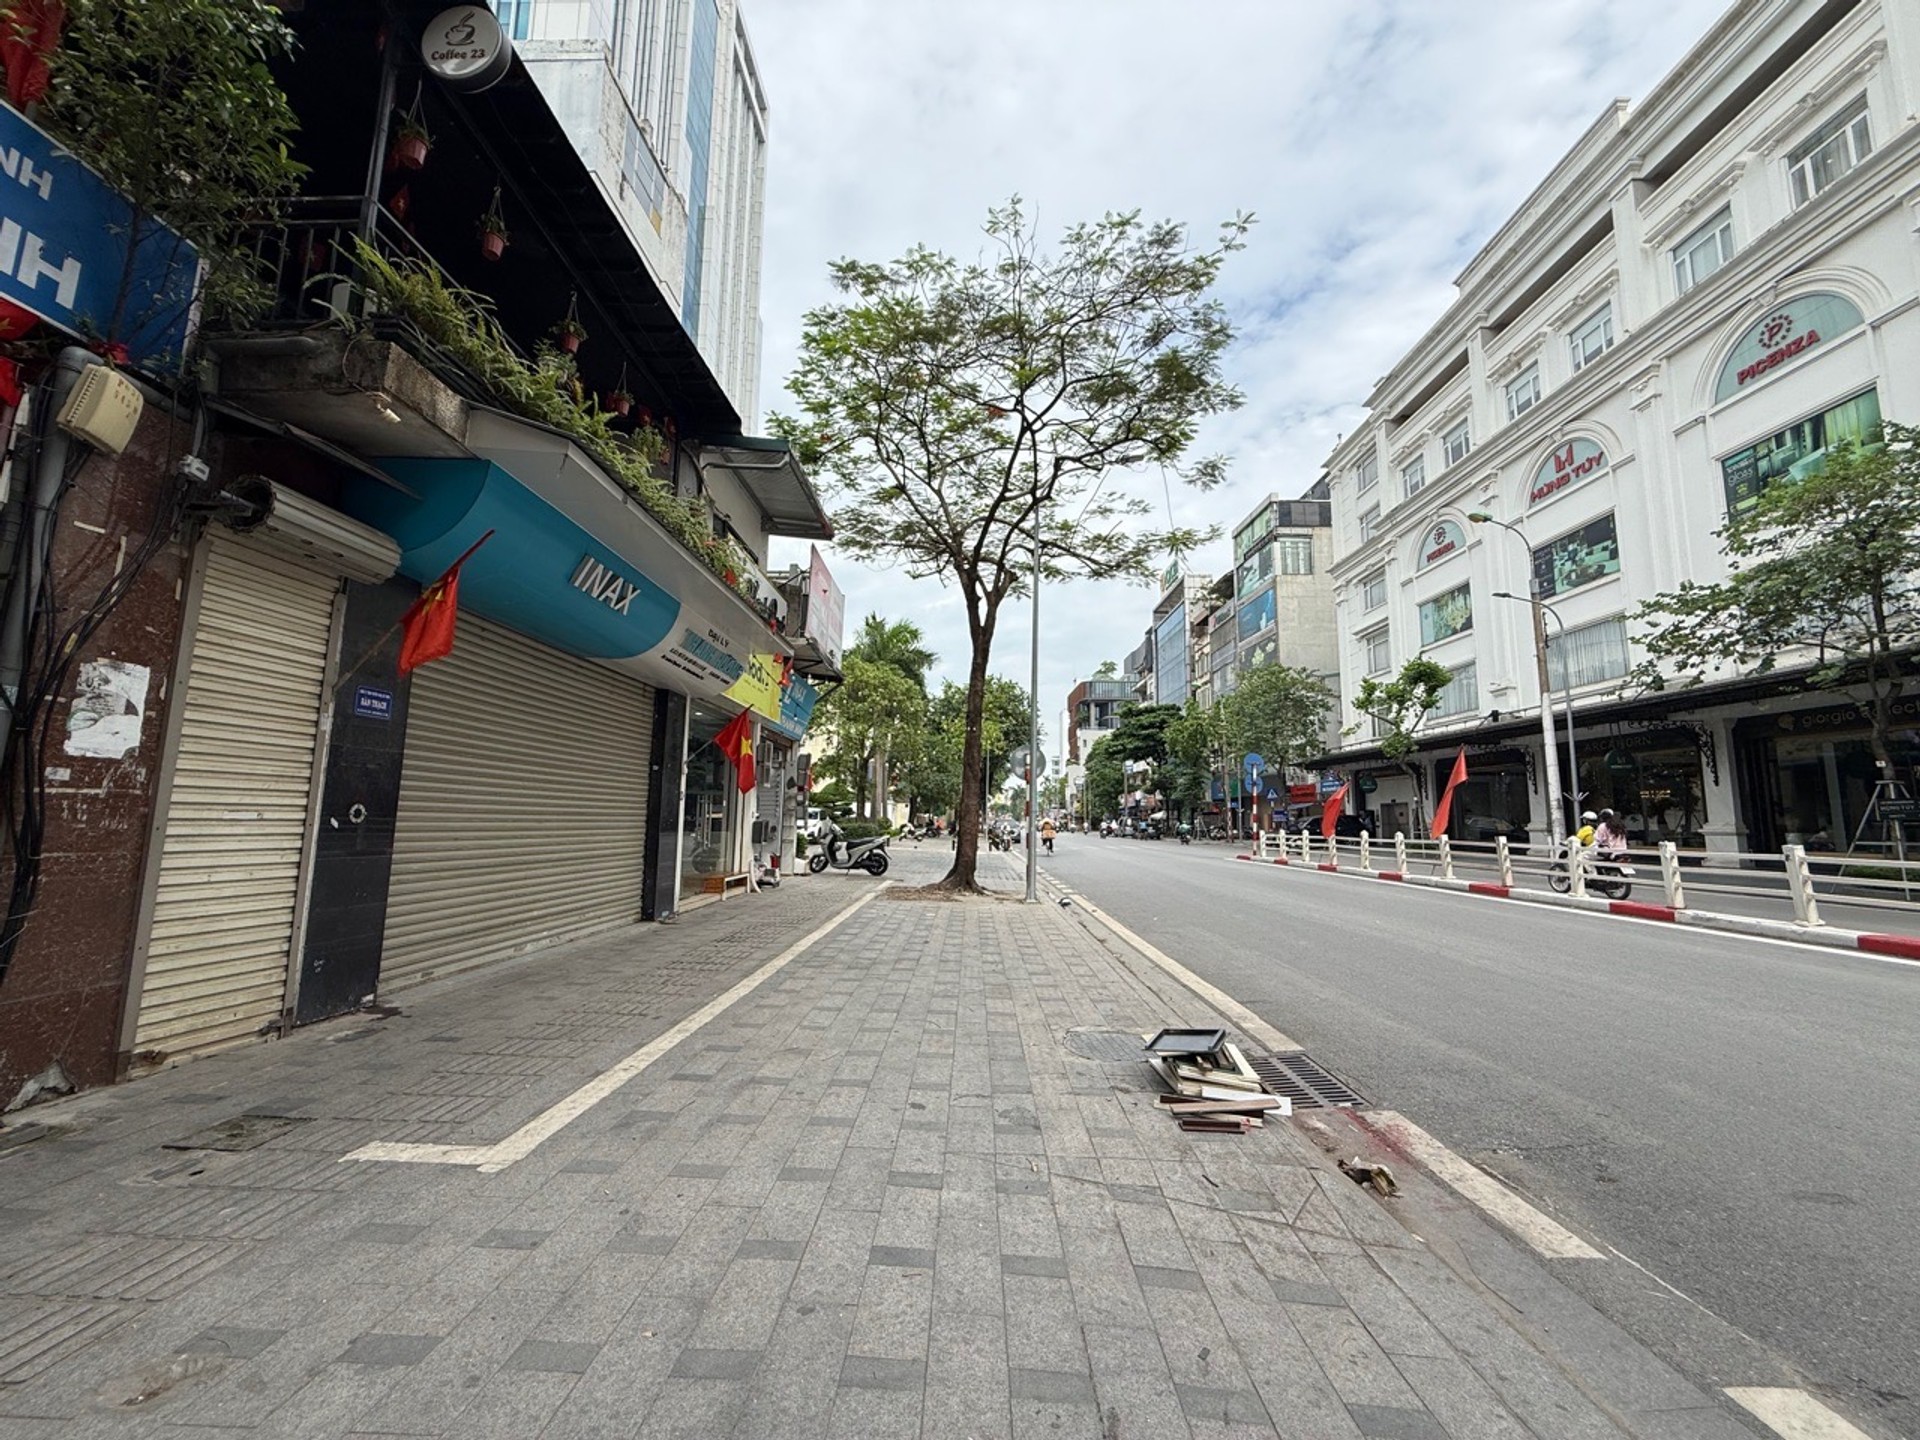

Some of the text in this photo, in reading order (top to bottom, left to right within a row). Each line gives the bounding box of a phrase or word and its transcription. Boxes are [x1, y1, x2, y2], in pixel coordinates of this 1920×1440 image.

[431, 49, 485, 60] Coffee 23
[1737, 329, 1821, 385] PICENZA
[573, 556, 642, 616] INAX
